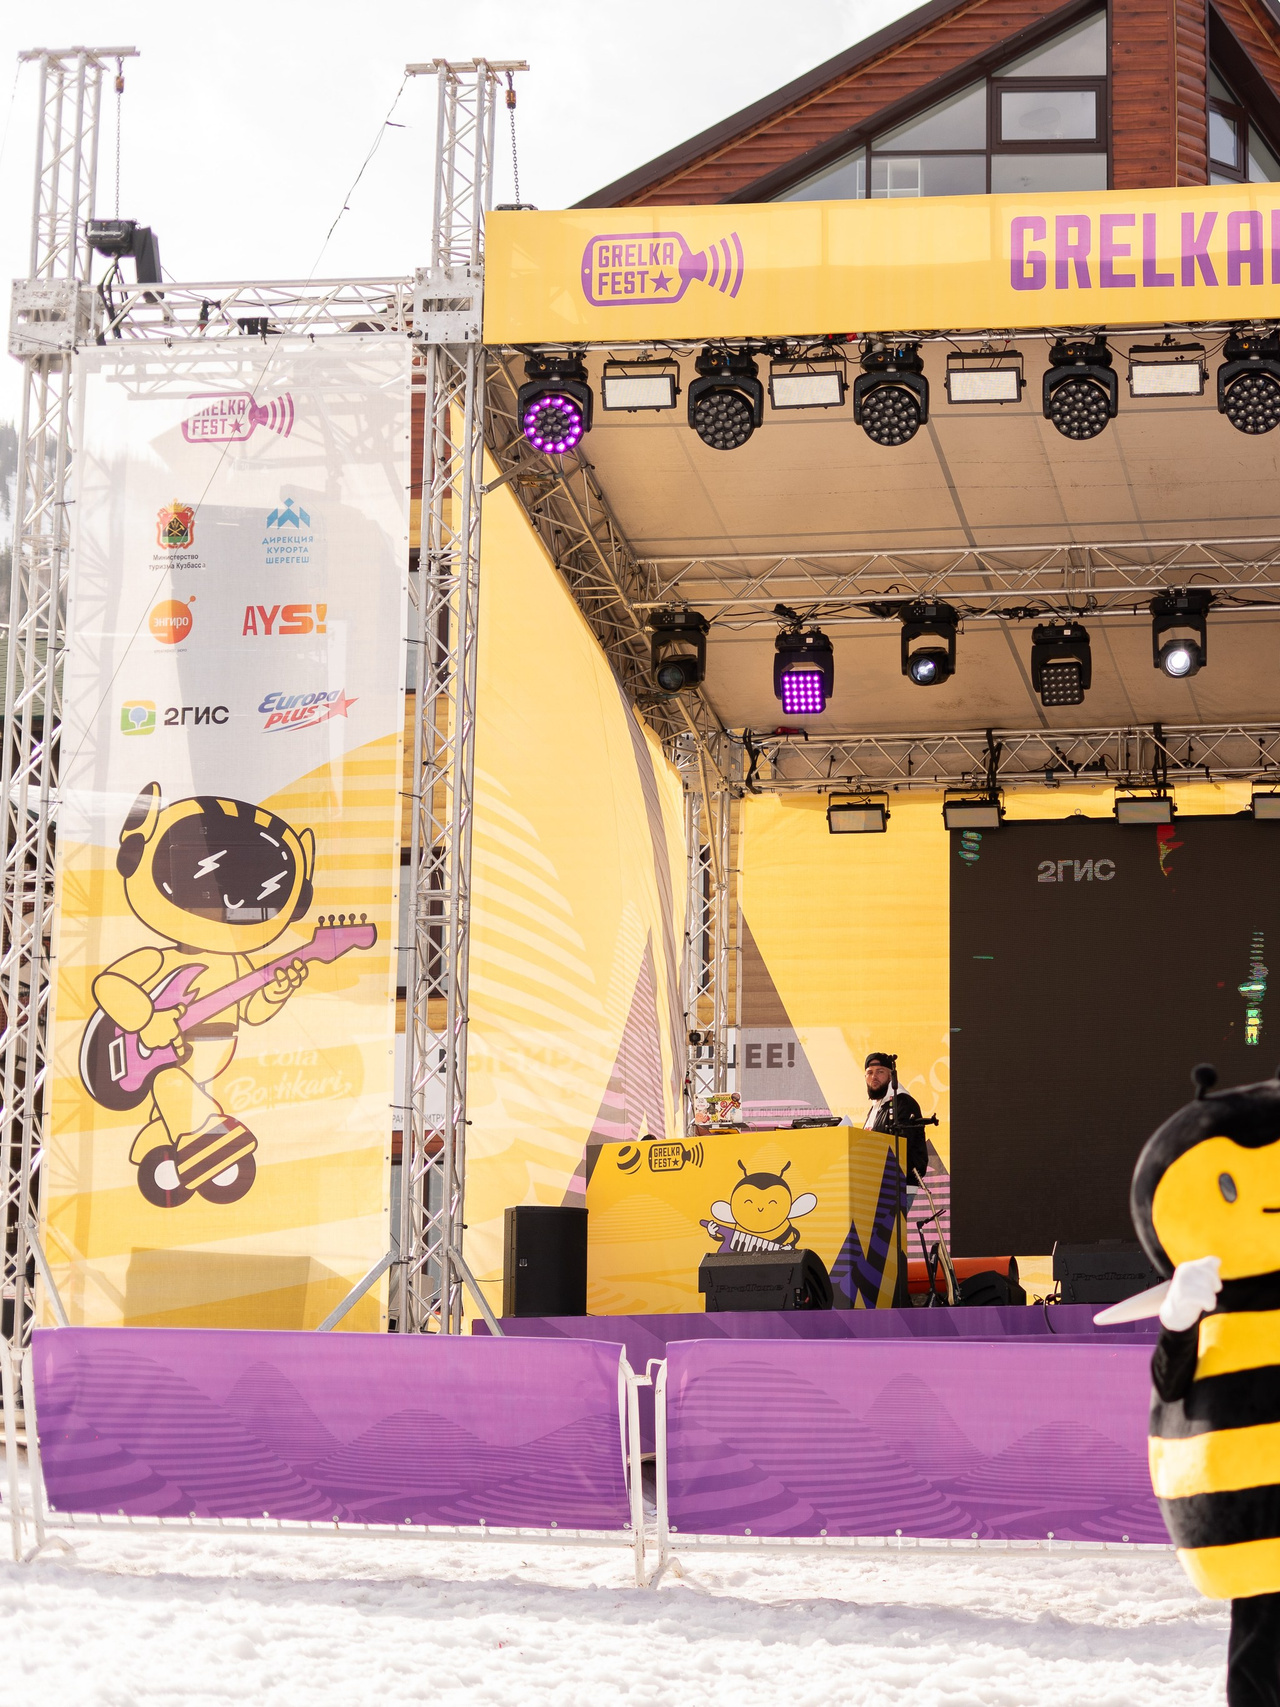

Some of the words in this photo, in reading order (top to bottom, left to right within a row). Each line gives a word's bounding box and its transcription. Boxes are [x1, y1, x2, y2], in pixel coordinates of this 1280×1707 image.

[598, 242, 674, 268] GRELKA
[598, 270, 649, 296] FEST
[193, 399, 246, 417] RELKA
[192, 418, 228, 435] FEST
[261, 535, 314, 545] ДИРЕКЦИЯ
[266, 546, 309, 554] КУРОРТА
[152, 554, 199, 562] Министерство
[265, 556, 310, 564] ШЕРЕГЕШ
[153, 615, 189, 629] энгиро
[242, 603, 328, 636] AYS!
[164, 706, 230, 726] 2ГИС
[1037, 858, 1116, 883] 2ГИС
[653, 1146, 681, 1158] GRELKA
[653, 1157, 672, 1168] FEST
